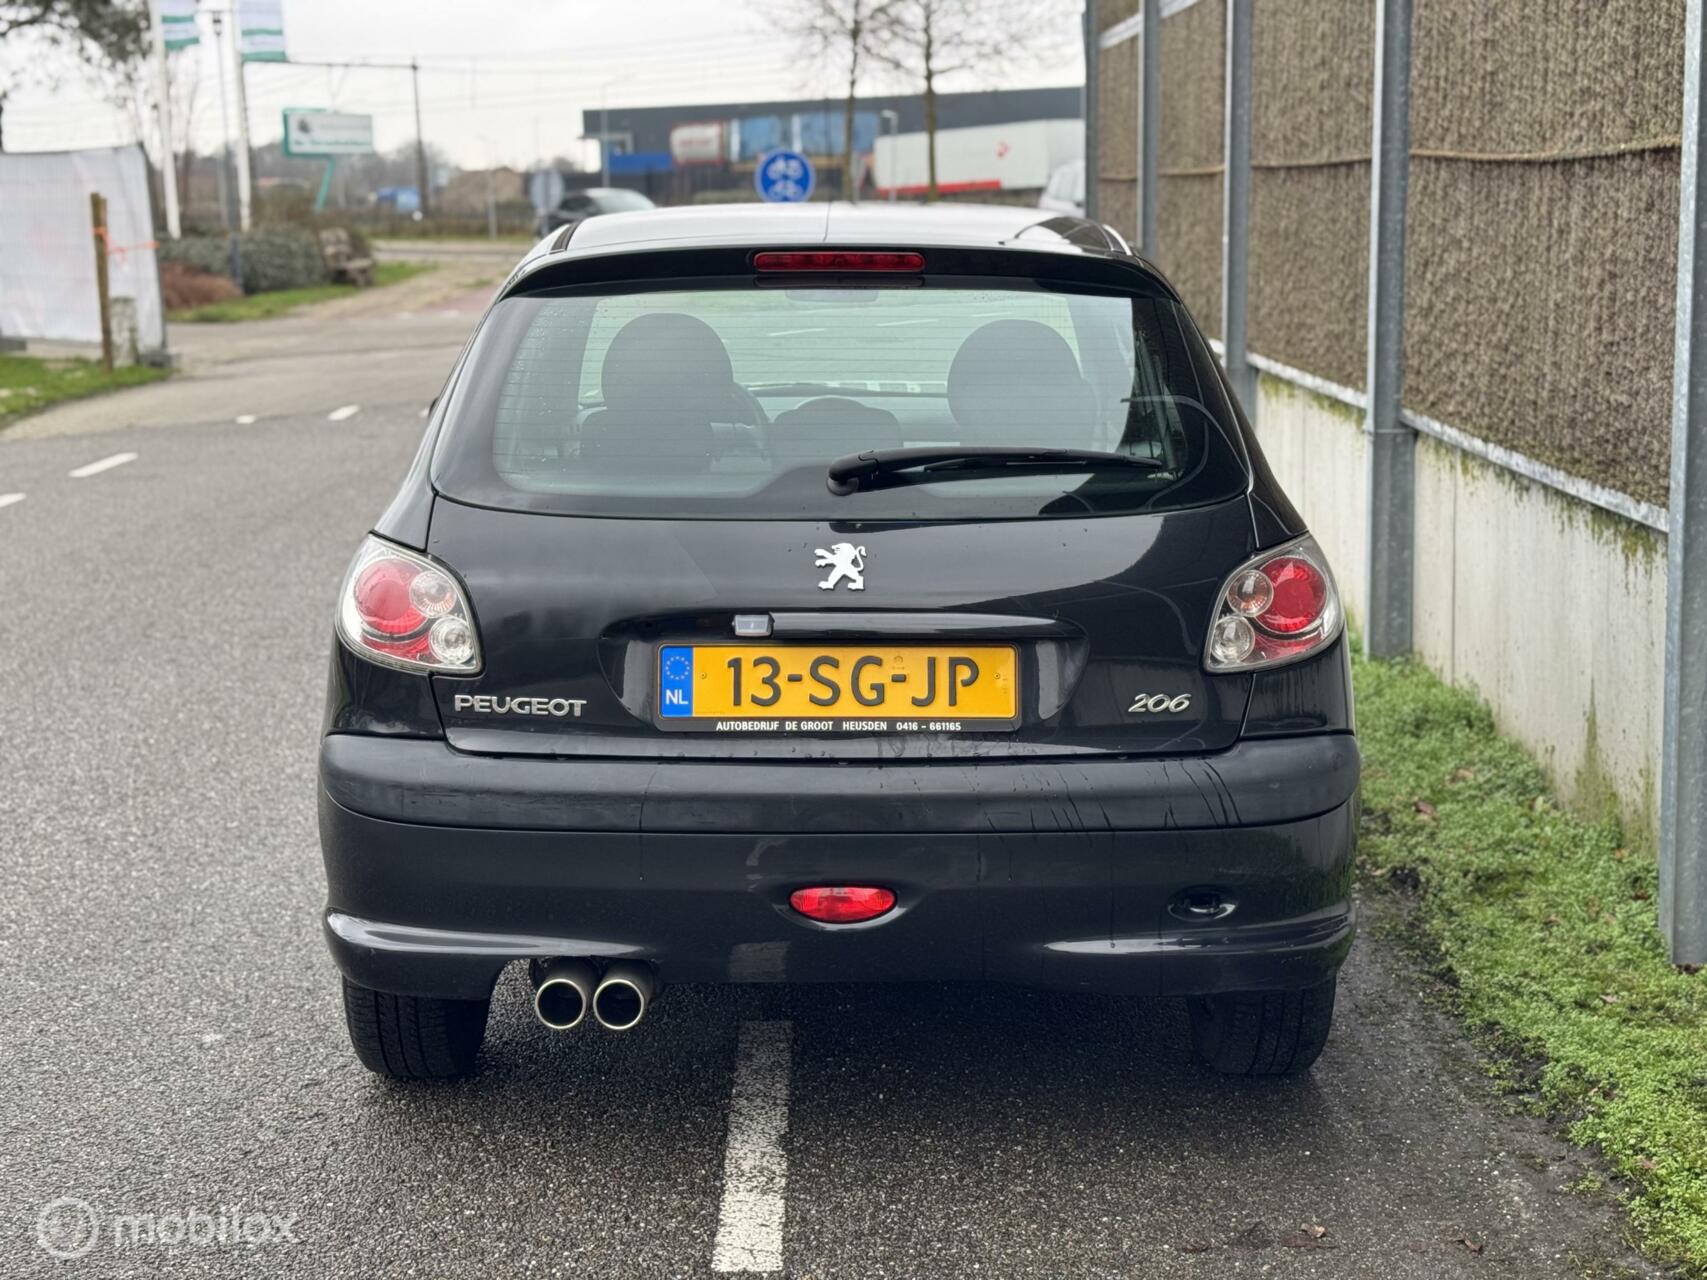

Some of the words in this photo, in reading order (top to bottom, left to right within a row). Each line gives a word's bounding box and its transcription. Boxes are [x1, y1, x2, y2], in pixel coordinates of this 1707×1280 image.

[727, 655, 980, 708] 13-SG-JP
[454, 694, 587, 717] PEUGEOT
[665, 689, 689, 705] NL
[1127, 693, 1192, 713] 206
[716, 721, 780, 731] AUTOBEDRIJF
[785, 721, 798, 731] DE
[800, 721, 834, 731] GROOT
[842, 721, 887, 731] HEUSDEN
[896, 721, 918, 731] 0416
[929, 721, 962, 731] 661165
